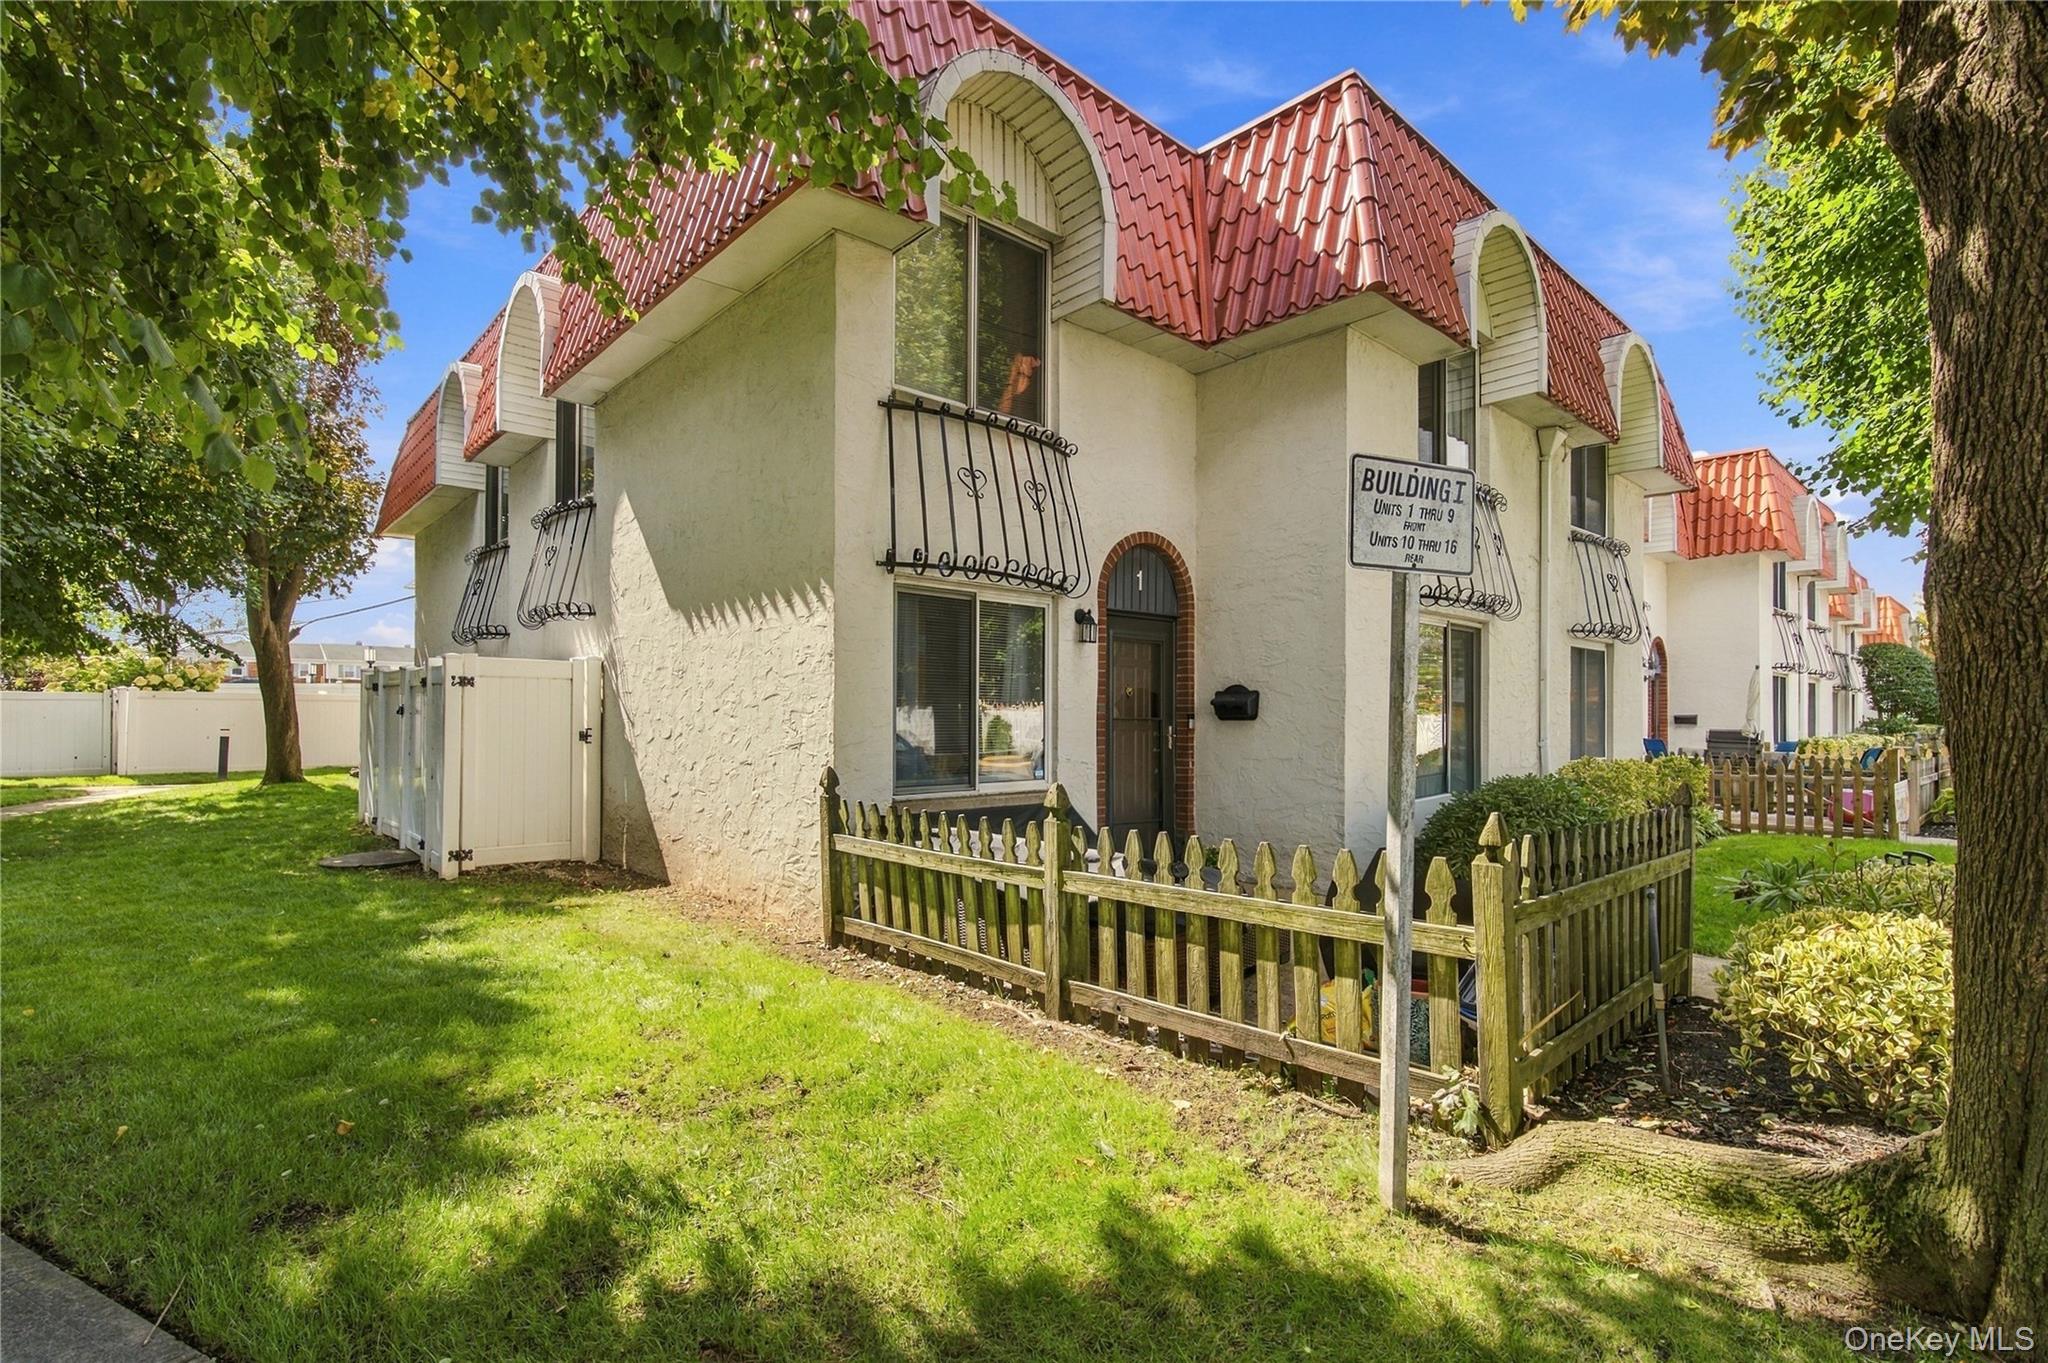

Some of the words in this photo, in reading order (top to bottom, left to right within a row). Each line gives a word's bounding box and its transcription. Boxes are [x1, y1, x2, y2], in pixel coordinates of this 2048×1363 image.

[1361, 468, 1451, 504] BUILDING
[1373, 498, 1403, 517] UNITS
[1408, 503, 1414, 518] 1
[1420, 507, 1444, 521] THRU
[1447, 508, 1455, 523] 9
[1403, 521, 1426, 532] FRONT
[1369, 531, 1399, 549] UNITS
[1402, 535, 1415, 550] 10
[1418, 538, 1442, 553] THRU
[1445, 540, 1458, 554] 16
[1404, 553, 1425, 564] REAR
[1136, 570, 1143, 591] 1
